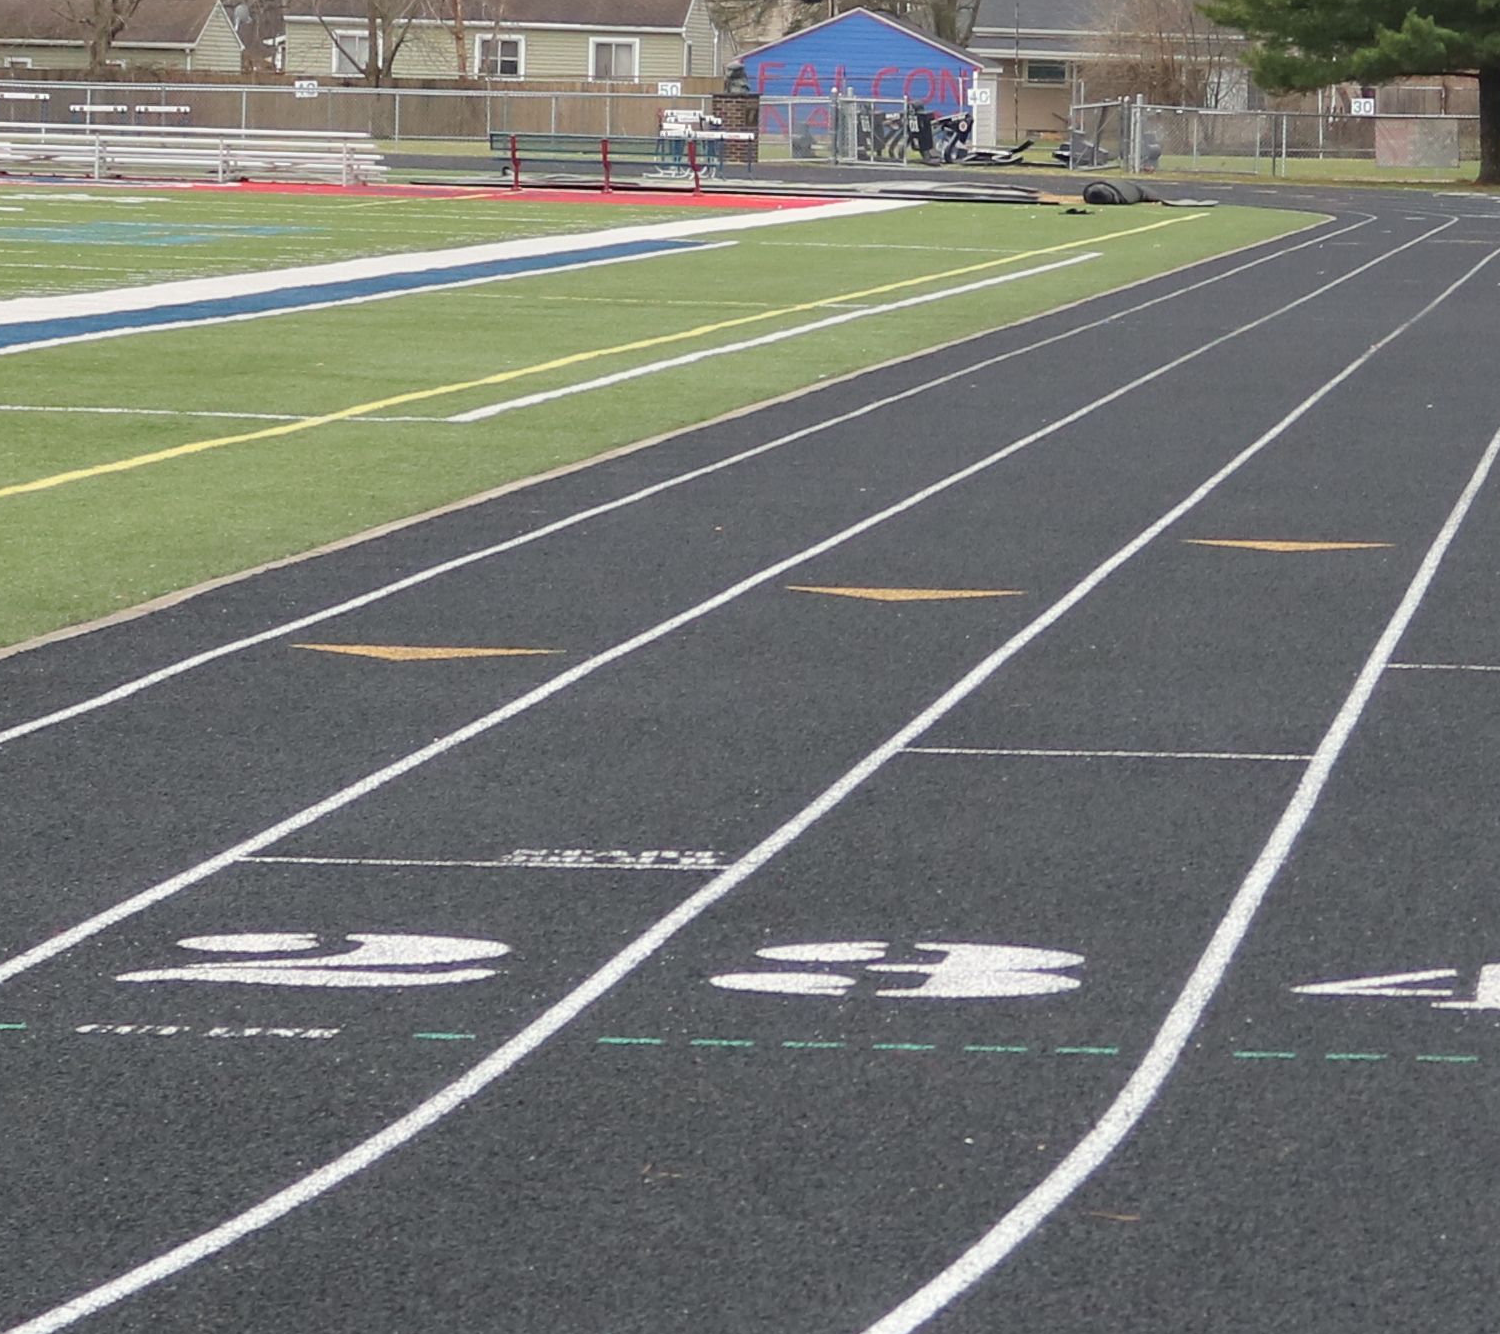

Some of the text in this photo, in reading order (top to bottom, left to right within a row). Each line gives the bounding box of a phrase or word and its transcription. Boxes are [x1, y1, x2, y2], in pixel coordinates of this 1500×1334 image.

[660, 84, 680, 96] 50
[1353, 100, 1373, 114] 30
[115, 933, 510, 987] 2
[710, 942, 1084, 998] 3
